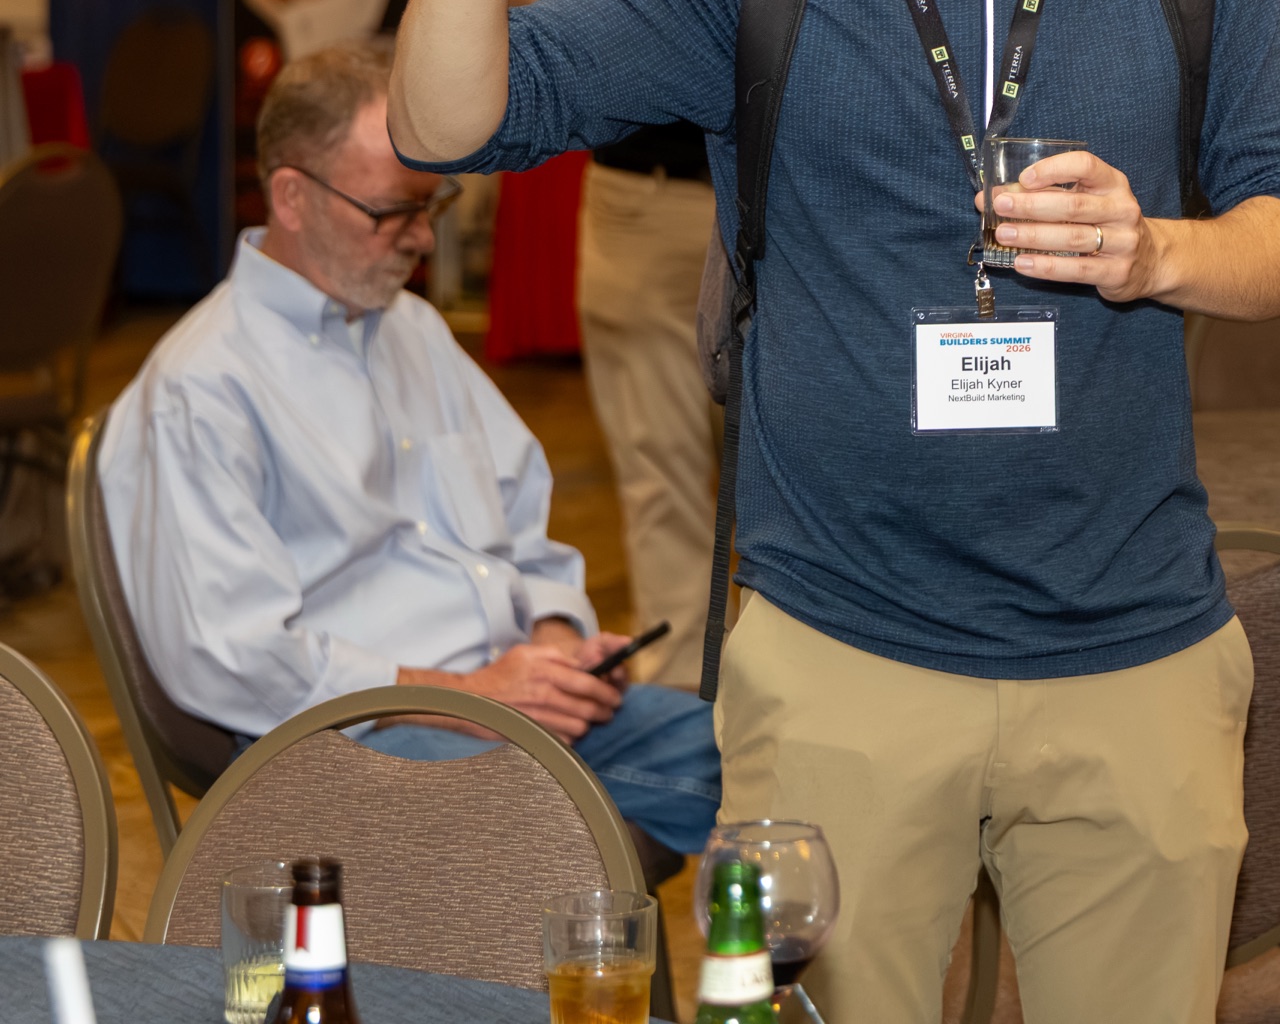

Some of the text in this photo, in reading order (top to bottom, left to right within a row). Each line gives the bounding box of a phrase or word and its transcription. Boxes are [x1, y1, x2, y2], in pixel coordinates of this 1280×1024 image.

[1008, 45, 1023, 80] TERRA
[942, 61, 959, 99] TERRA
[940, 337, 1031, 346] BUILDERS SUMMIT
[961, 356, 1011, 375] Elijah
[951, 378, 1023, 392] Elijah Kyner
[948, 394, 1025, 402] NextBuild Marketing
